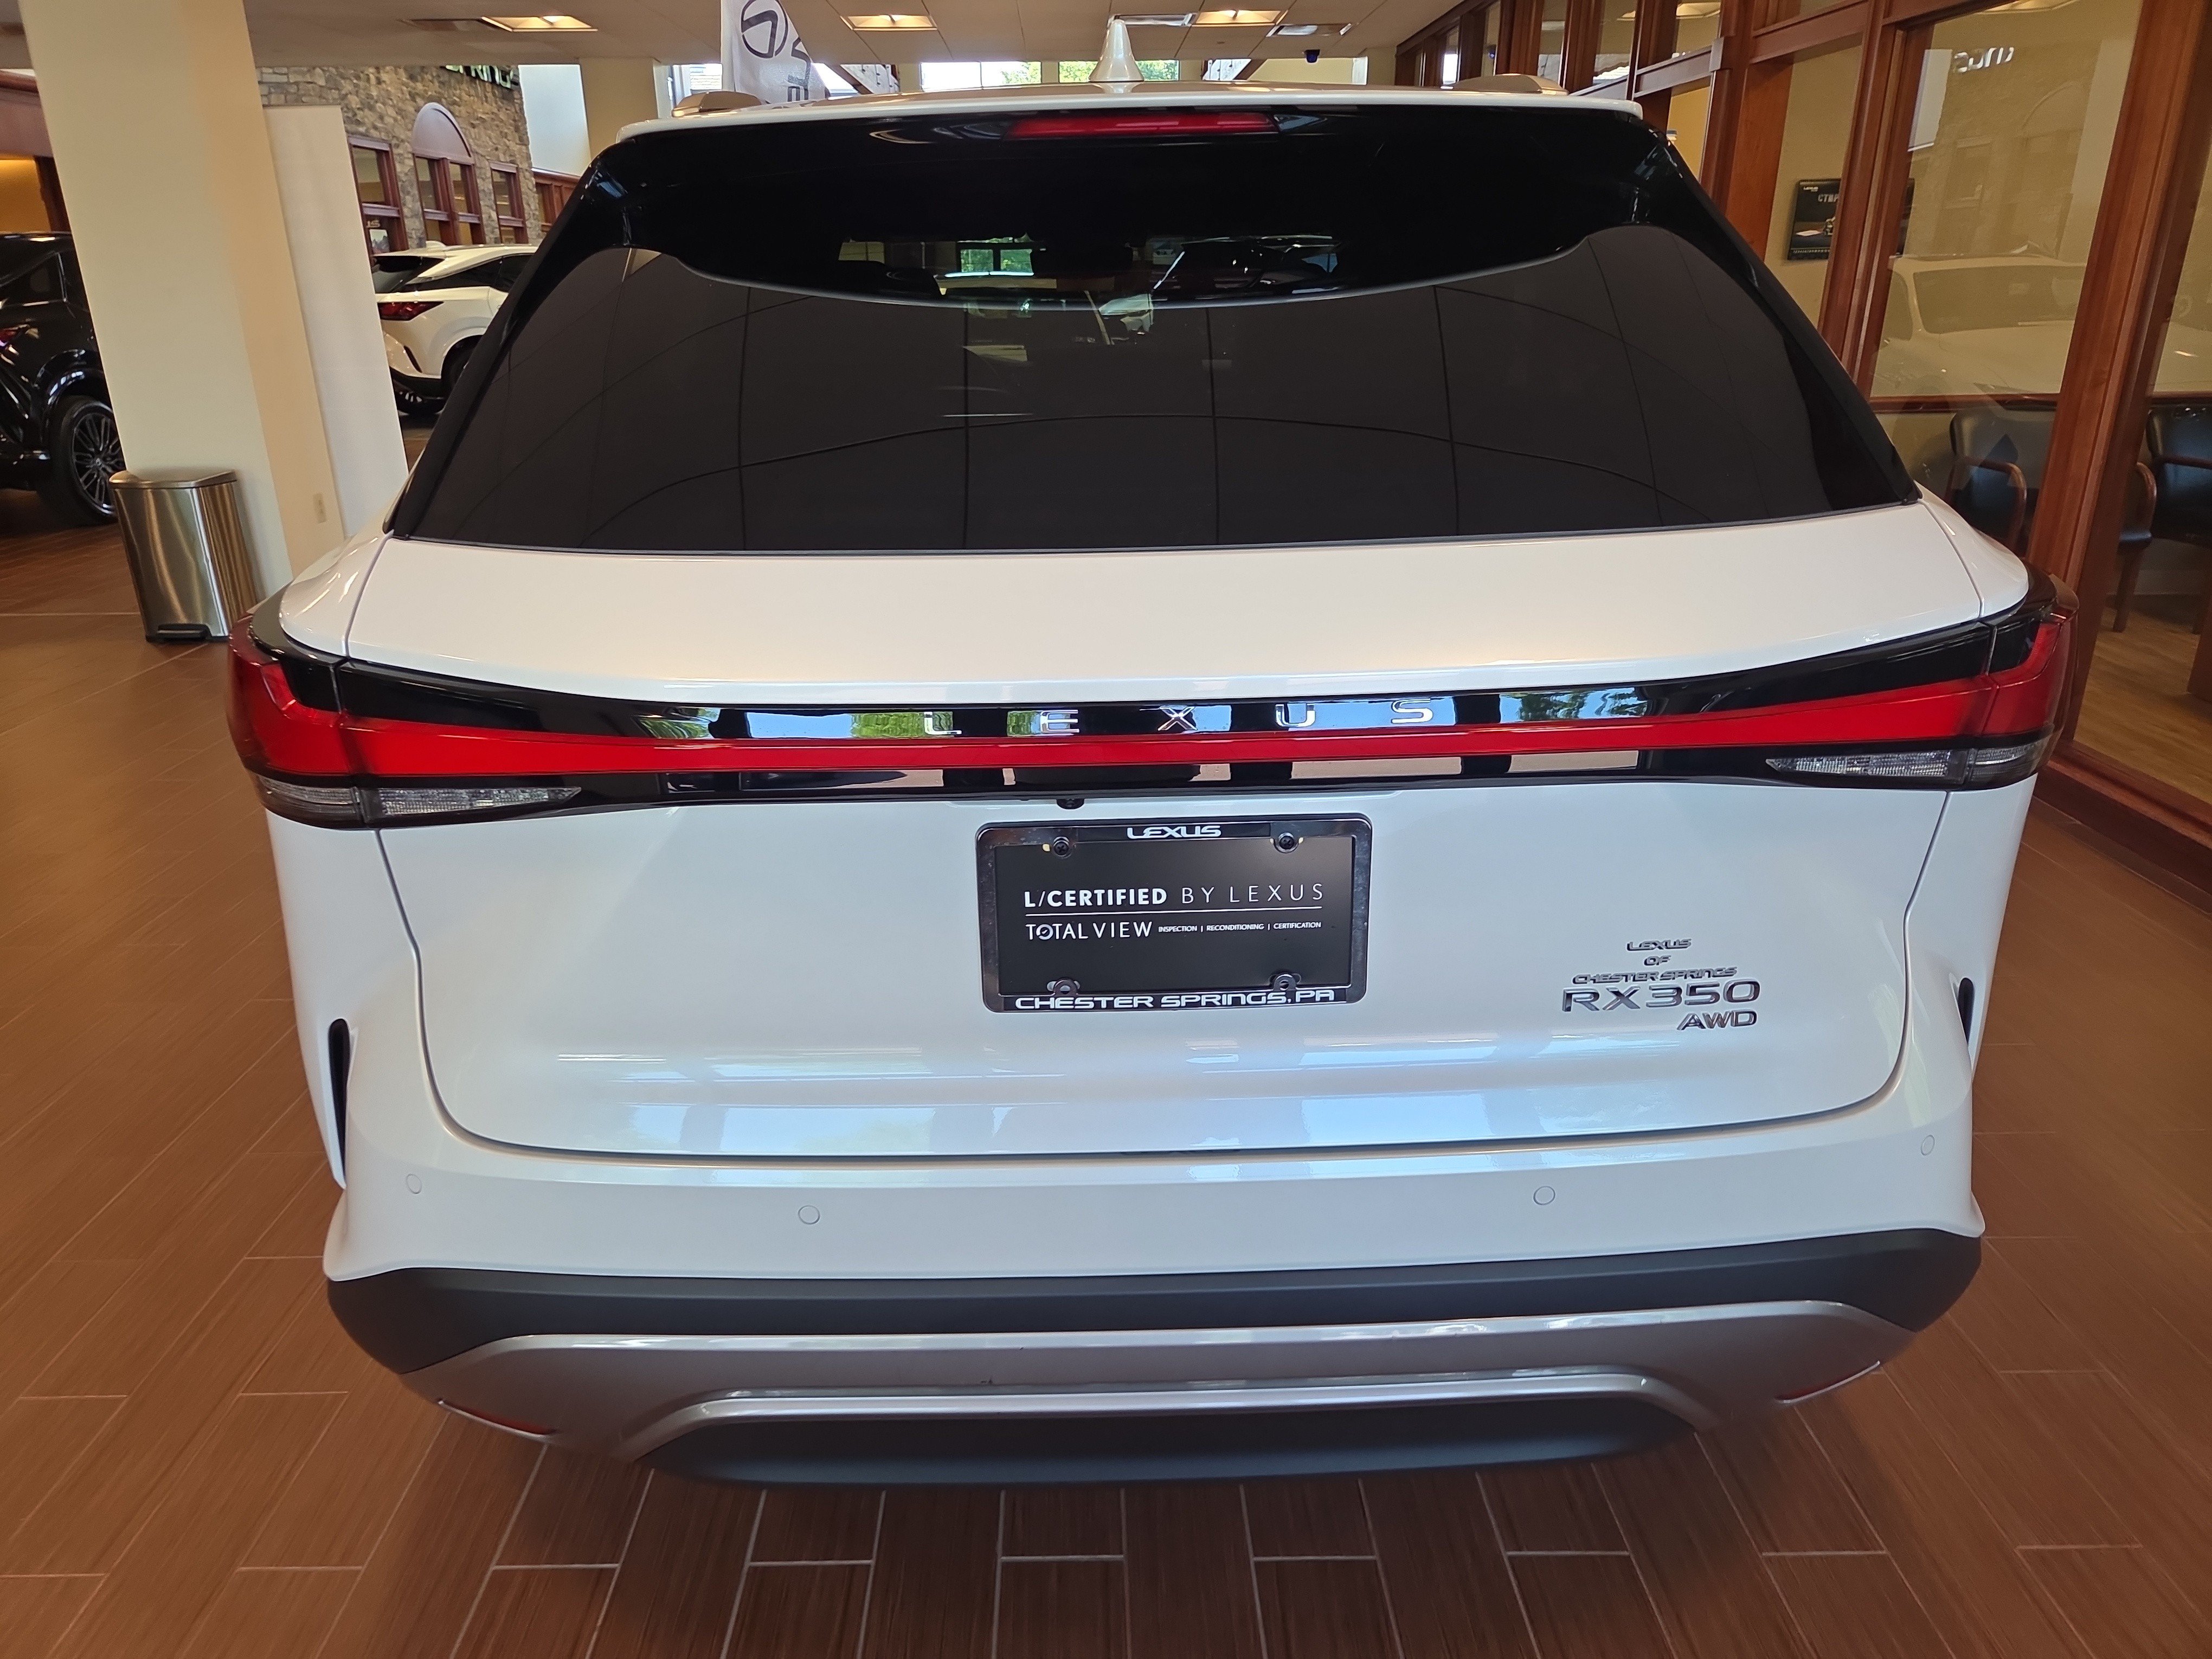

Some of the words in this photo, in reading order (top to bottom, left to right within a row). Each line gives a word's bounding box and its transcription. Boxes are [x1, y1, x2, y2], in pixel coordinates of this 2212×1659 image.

[924, 699, 1433, 735] LEXUS
[1127, 825, 1221, 839] LEXUS
[1024, 888, 1167, 908] L/CERTIFIED
[1181, 886, 1215, 904] BY
[1230, 883, 1323, 903] LEXUS
[1025, 923, 1089, 940] TOTAL
[1092, 921, 1153, 938] VIEW
[1158, 925, 1198, 933] INSPECTION
[1206, 923, 1265, 931] RECONDITIONING
[1273, 922, 1322, 930] CERTIFICATION
[1626, 938, 1692, 951] LEXUS
[1644, 955, 1672, 966] OF
[1572, 970, 1659, 985] CHESTER
[1659, 966, 1738, 981] SPRINGS
[1015, 995, 1154, 1009] CHESTER
[1676, 1010, 1758, 1031] AWD
